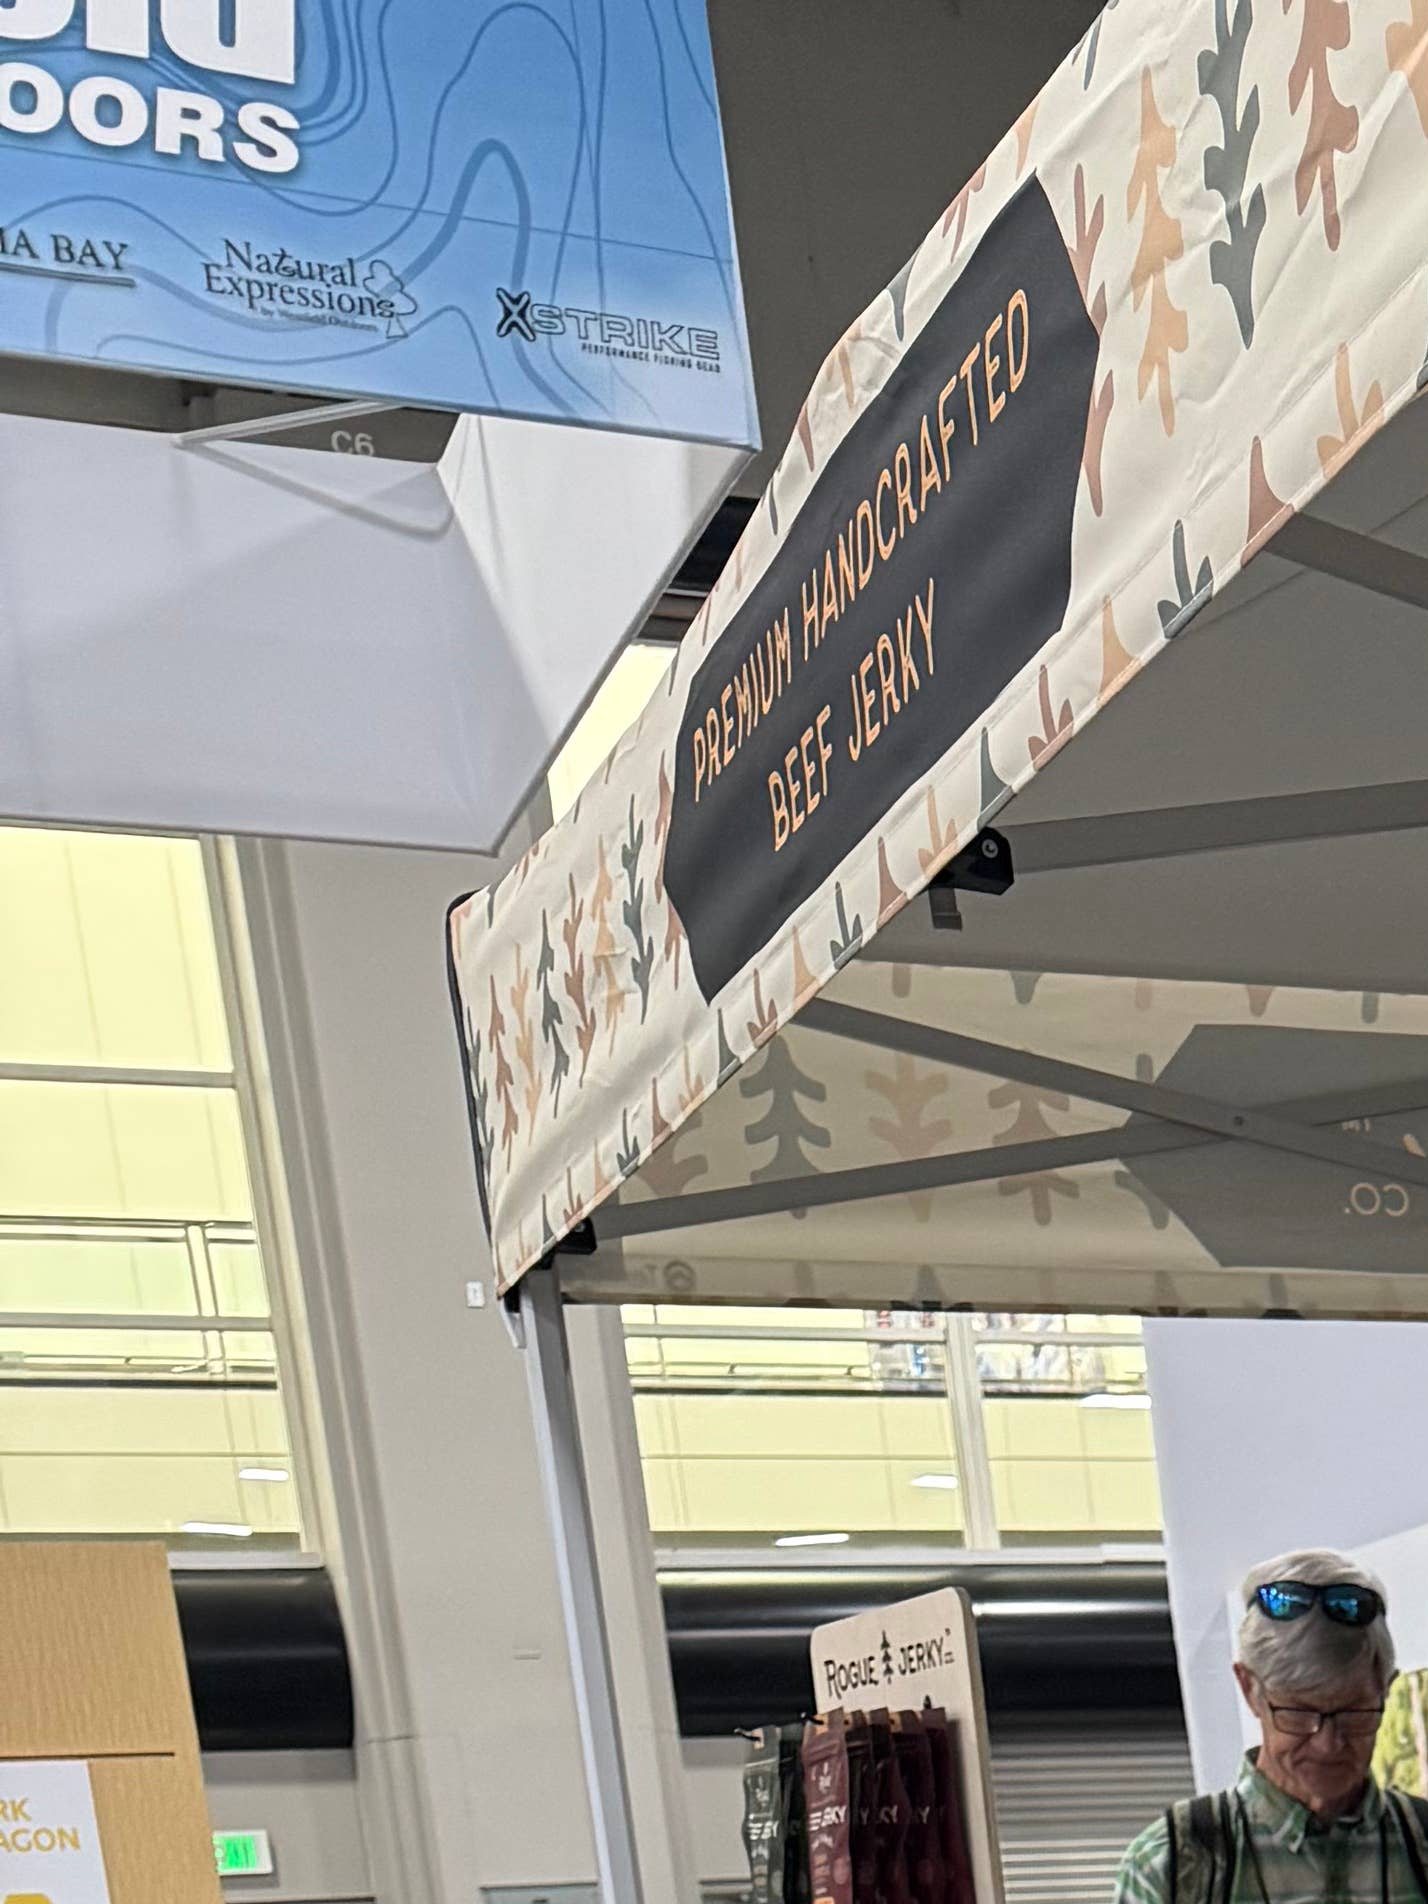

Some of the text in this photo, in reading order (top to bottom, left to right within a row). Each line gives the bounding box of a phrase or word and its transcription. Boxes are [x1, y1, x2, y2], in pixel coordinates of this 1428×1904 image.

[50, 233, 129, 270] BAY
[223, 237, 357, 289] Natural
[202, 261, 395, 319] Expressions
[694, 288, 1030, 802] PREMIUM HANDCRAFTED
[768, 577, 936, 854] BEEF JERKY
[824, 1636, 944, 1701] ROGUE JERKY
